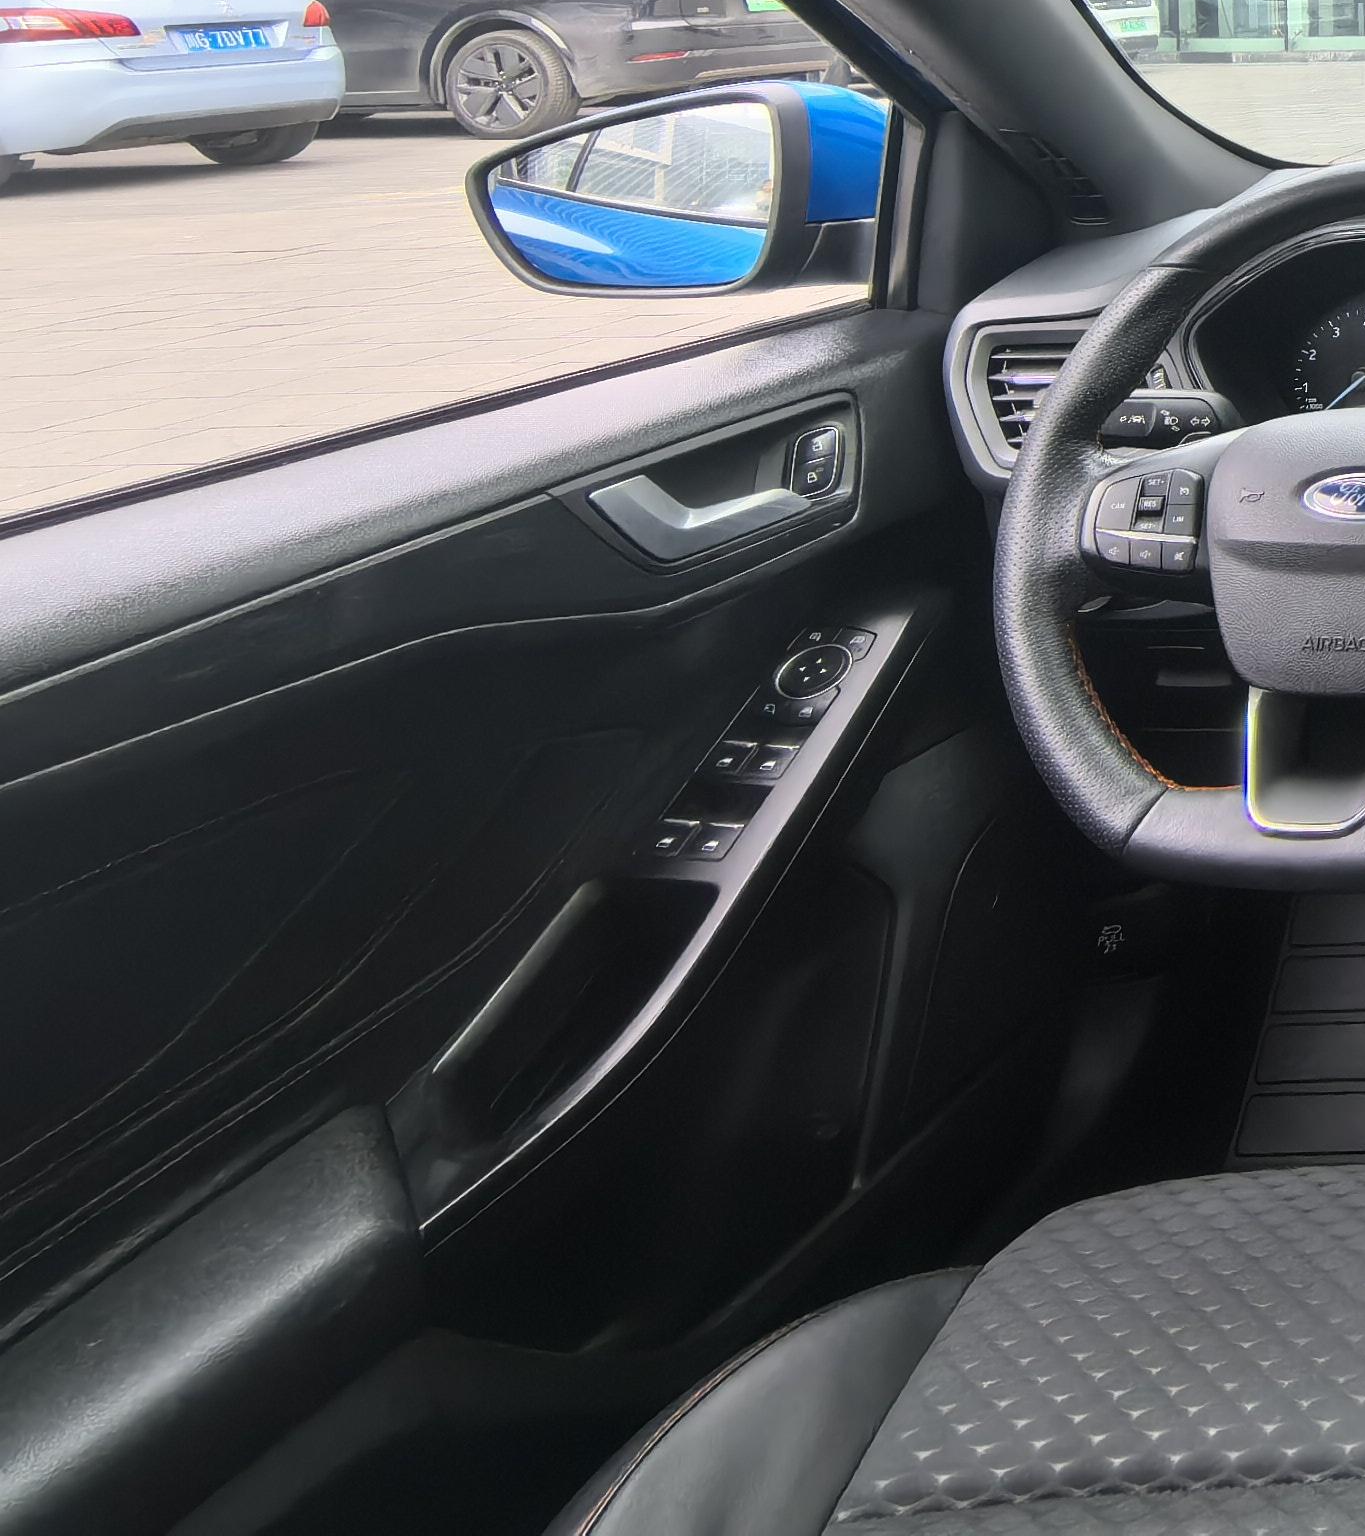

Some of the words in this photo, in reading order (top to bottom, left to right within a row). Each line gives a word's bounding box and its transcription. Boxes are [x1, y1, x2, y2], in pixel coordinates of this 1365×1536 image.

[1332, 327, 1340, 338] 3
[1308, 349, 1317, 361] 2
[1303, 382, 1308, 393] 1
[1172, 515, 1184, 523] LIM
